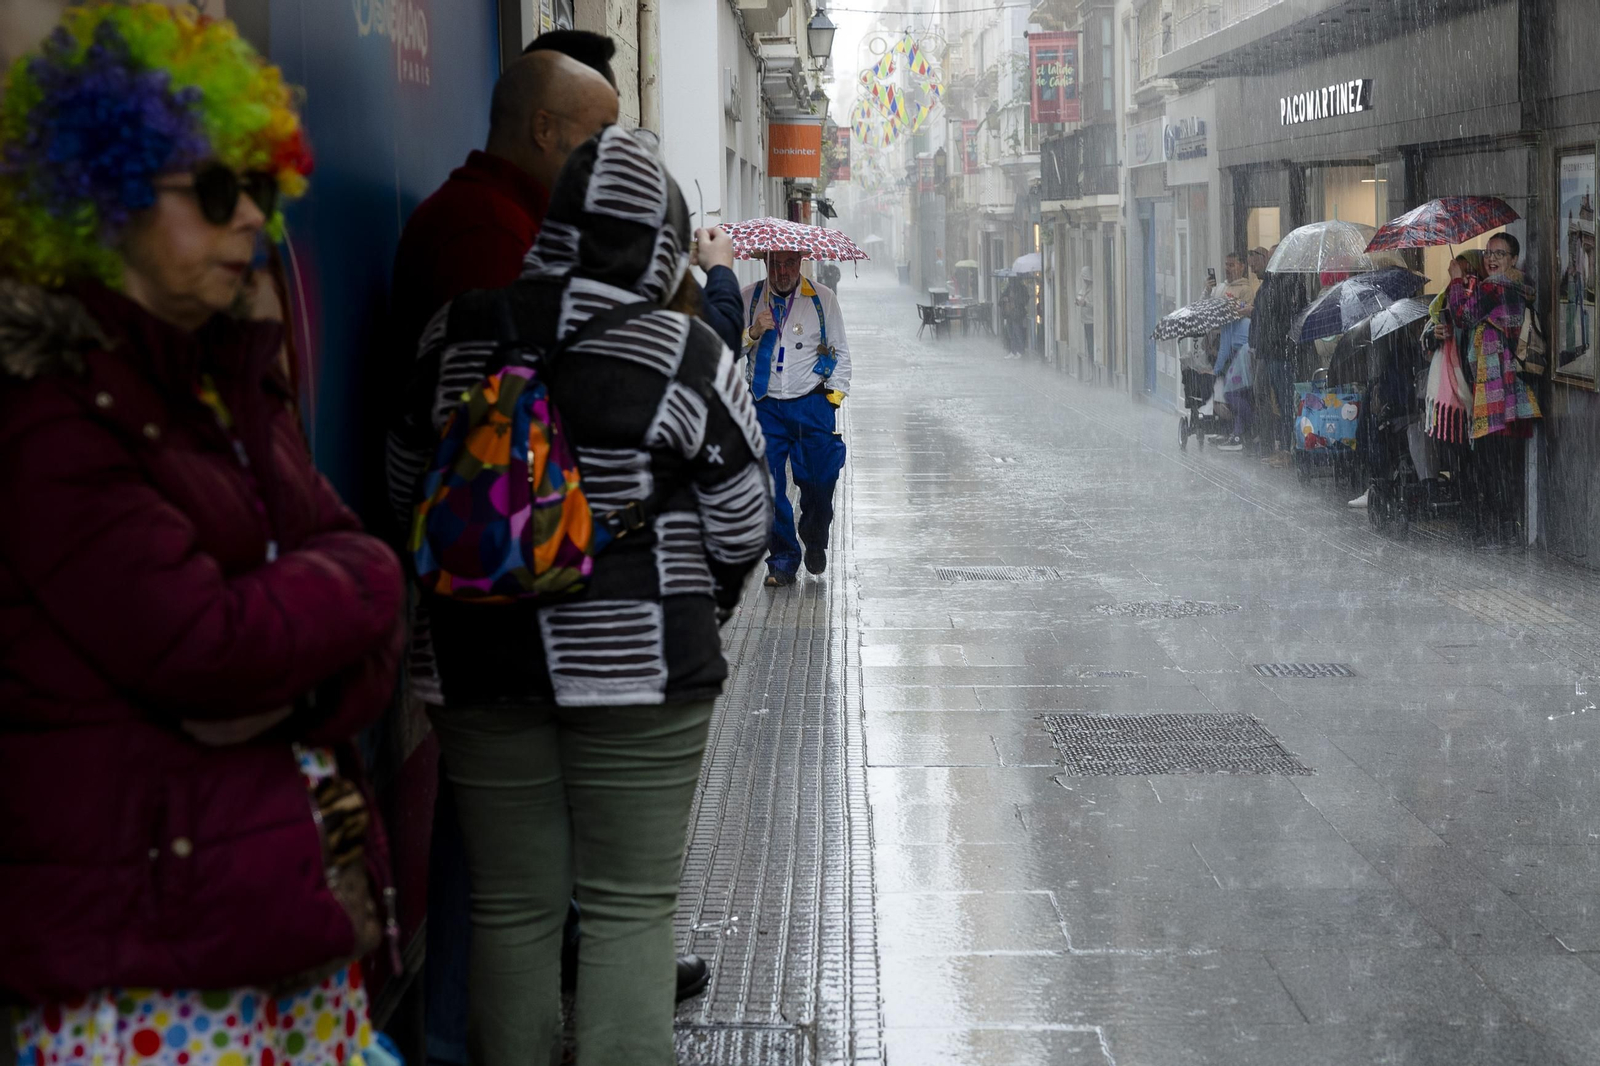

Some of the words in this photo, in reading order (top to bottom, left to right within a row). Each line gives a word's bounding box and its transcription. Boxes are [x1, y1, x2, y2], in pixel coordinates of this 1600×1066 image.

[402, 60, 430, 87] PARIS
[1048, 61, 1074, 75] latido
[1036, 75, 1047, 87] de
[1049, 76, 1074, 87] Cádiz
[1280, 79, 1363, 126] PACOMARTINEZ
